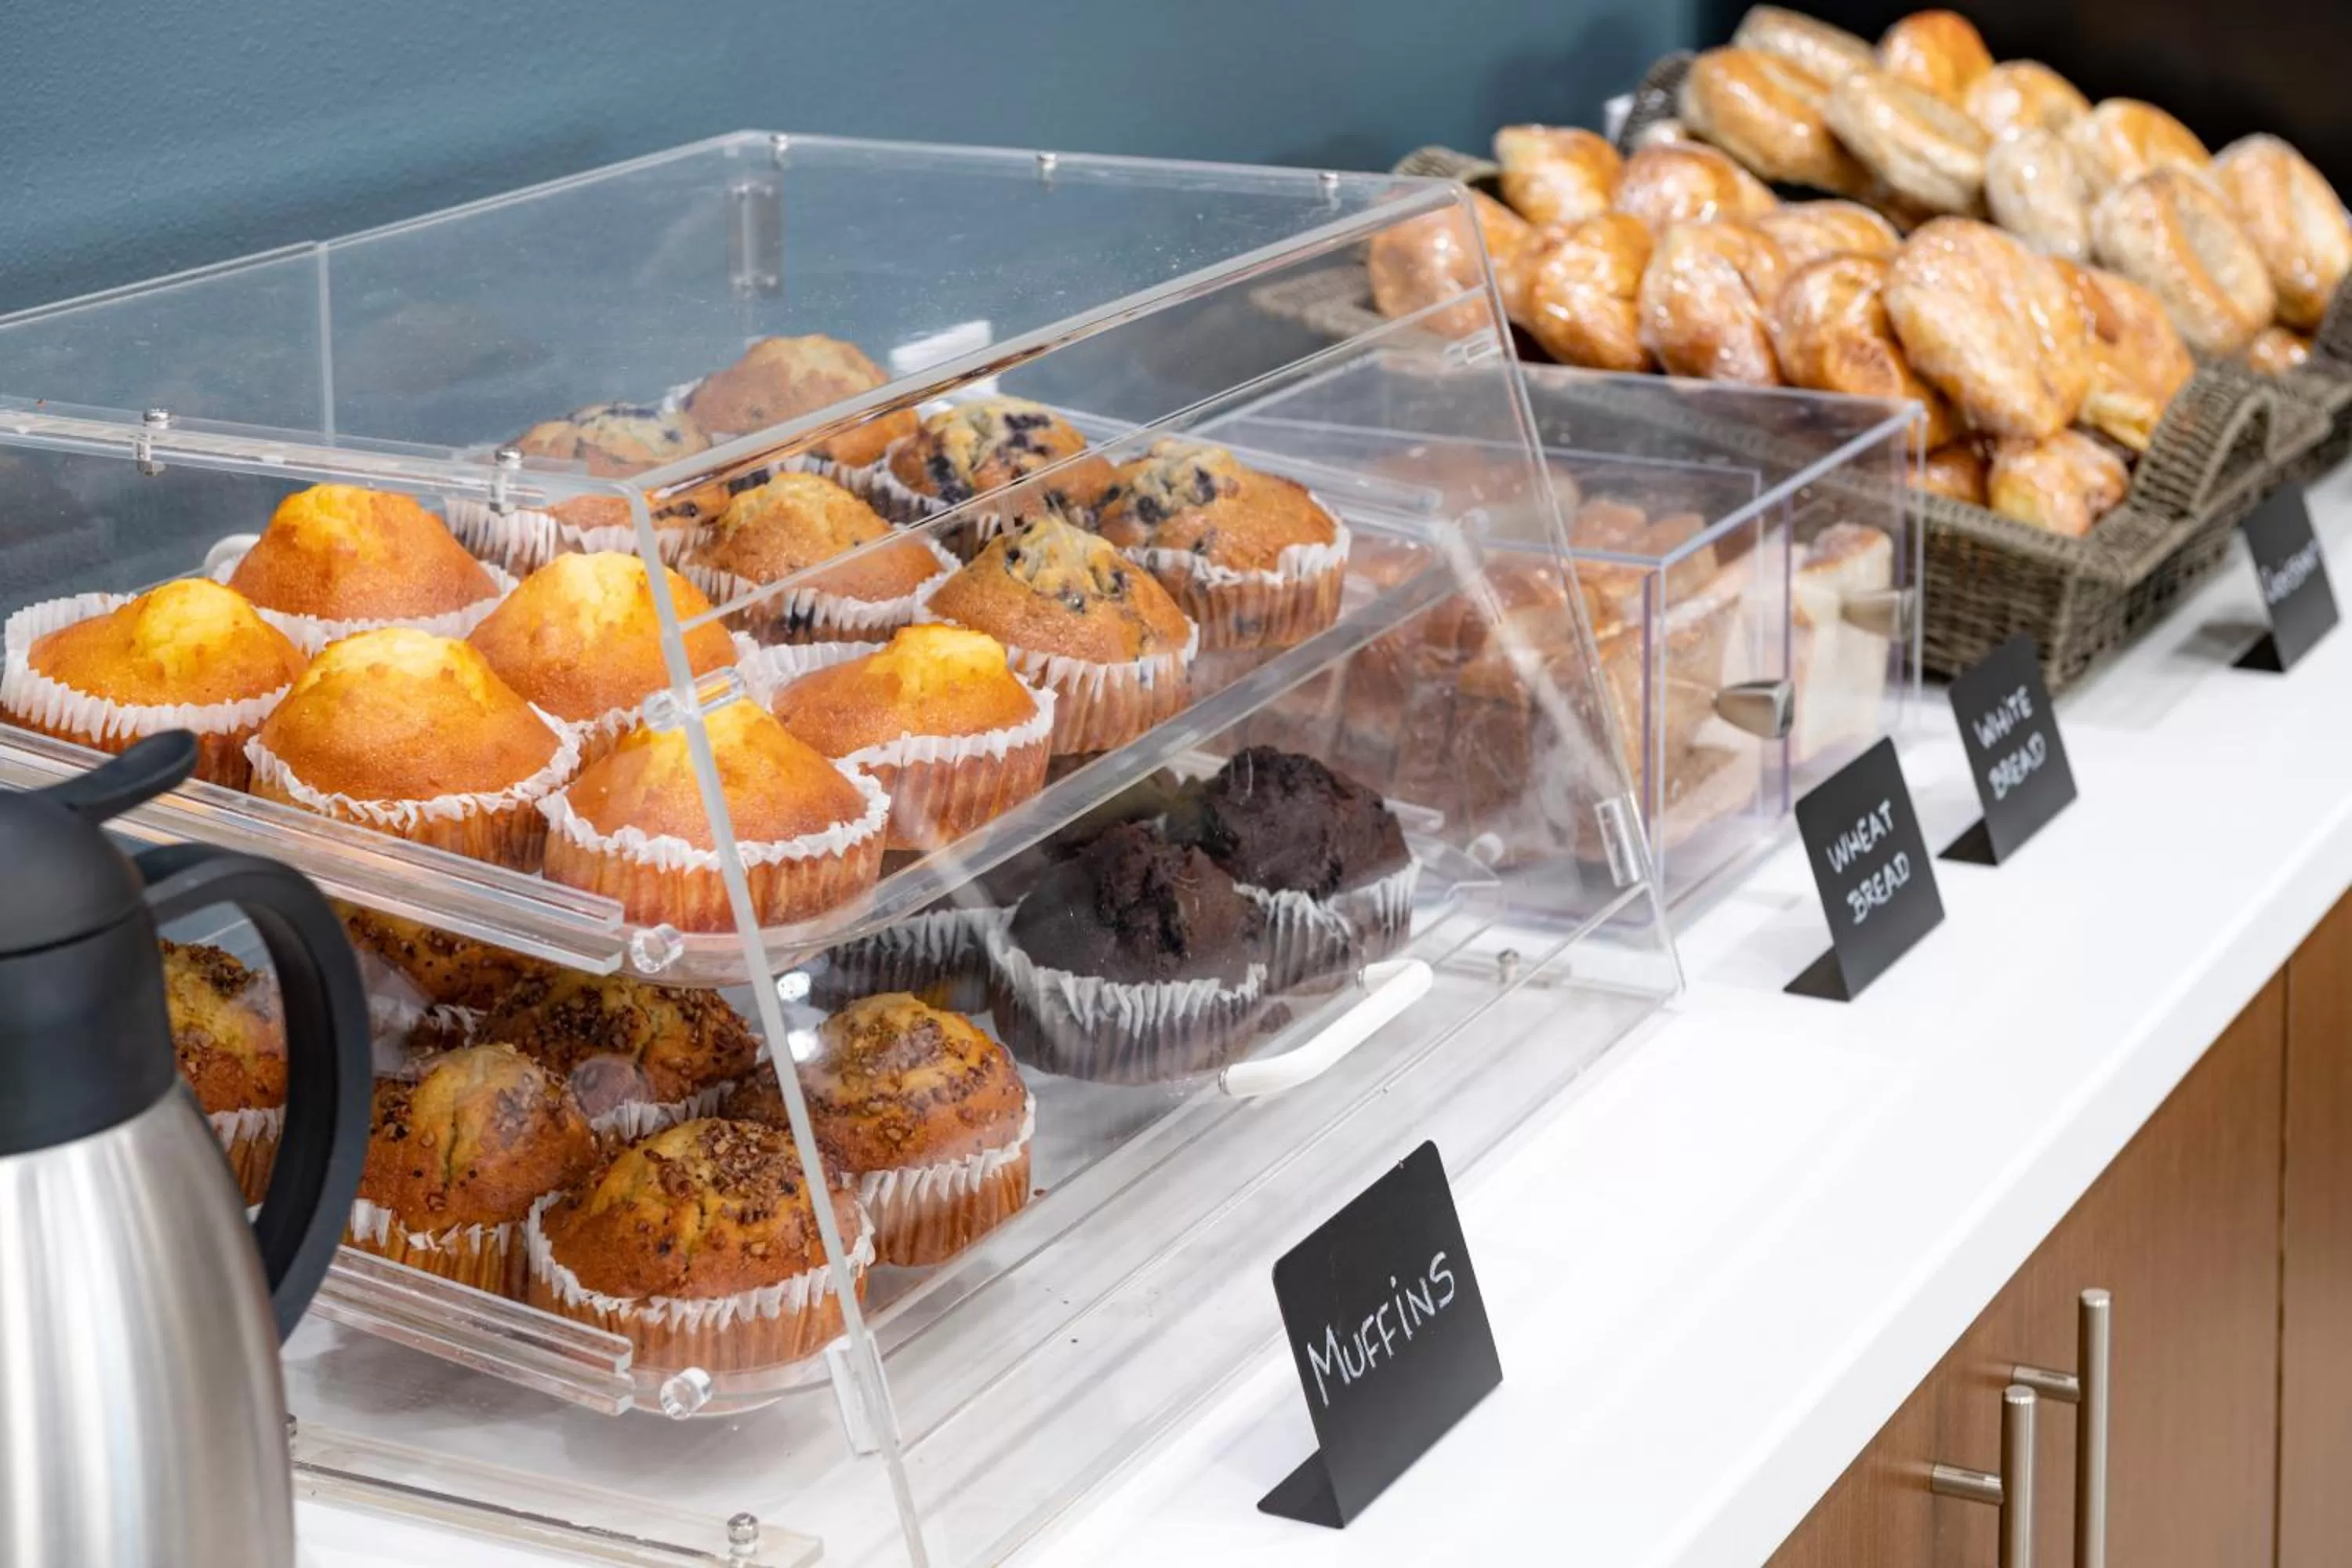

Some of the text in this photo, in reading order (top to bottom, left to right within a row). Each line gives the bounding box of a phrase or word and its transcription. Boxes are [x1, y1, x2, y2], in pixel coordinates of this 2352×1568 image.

[1988, 732, 2046, 801] BREAD
[1826, 799, 1893, 874] WHEAT
[1846, 851, 1911, 925] BREAD
